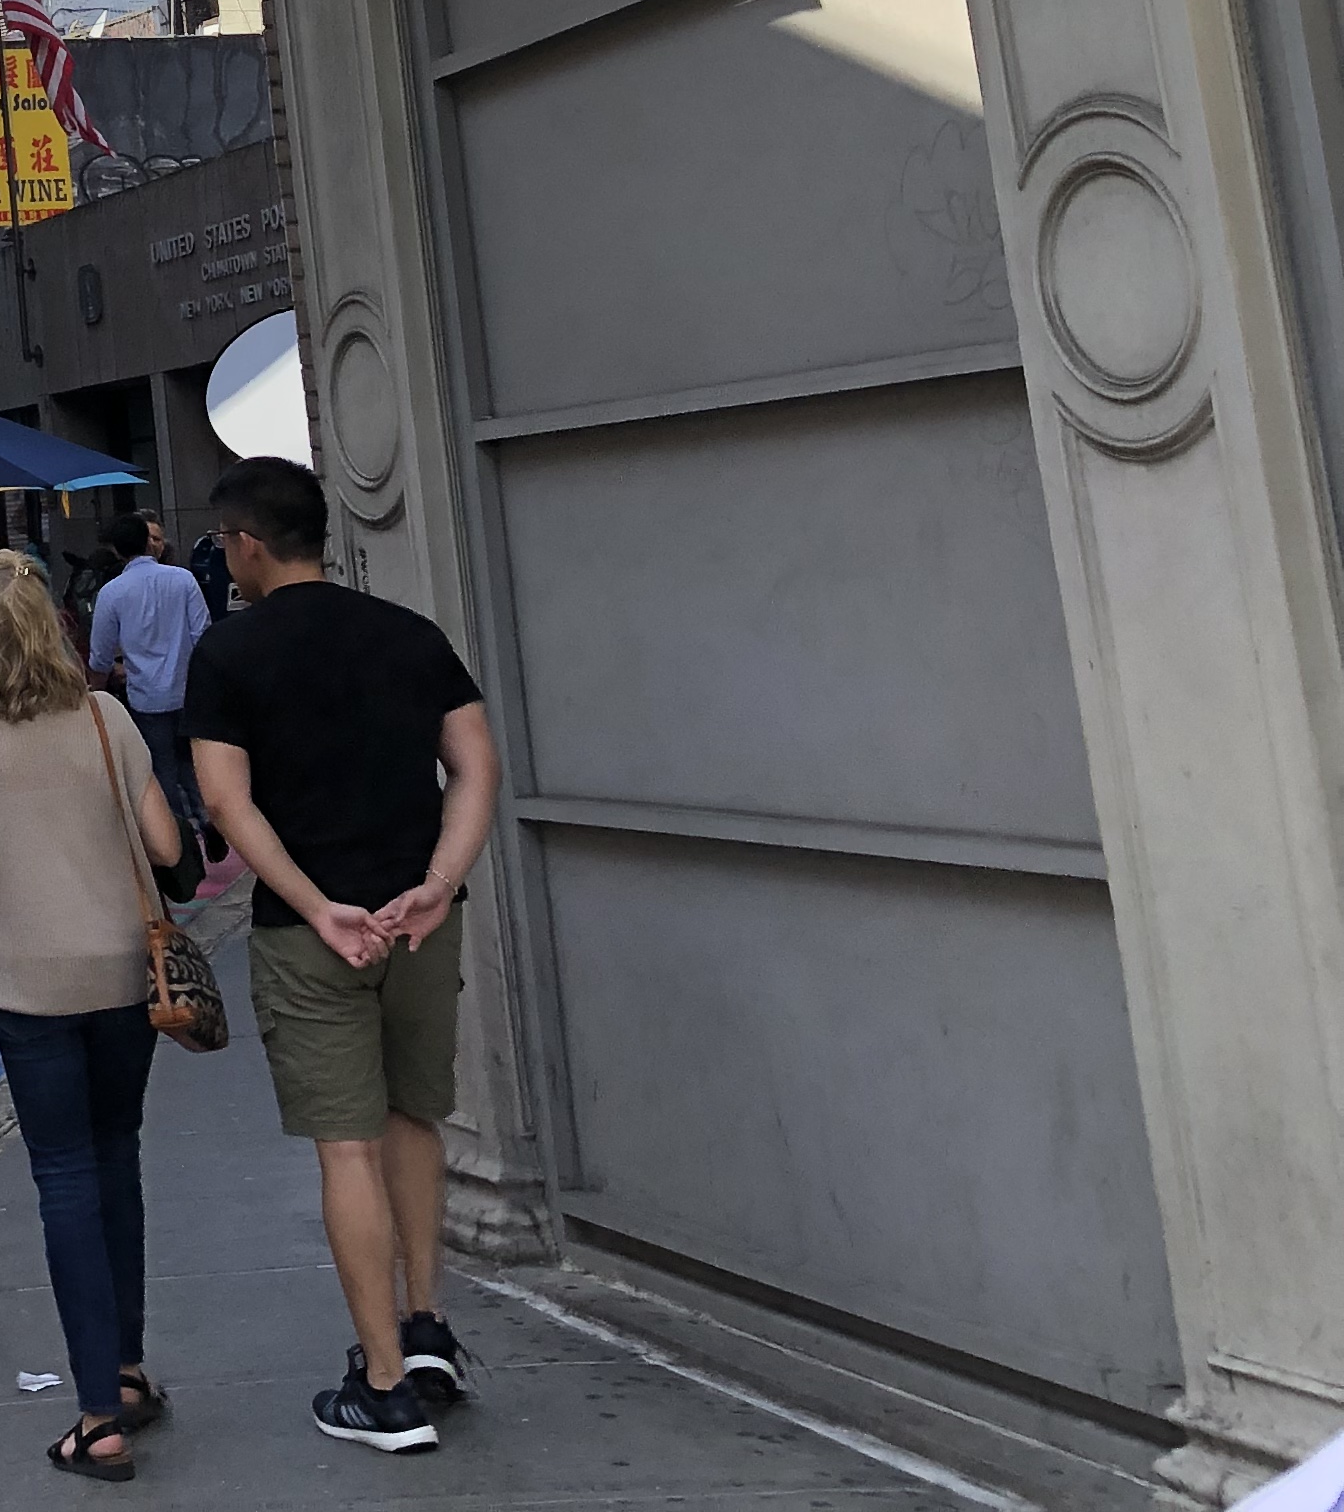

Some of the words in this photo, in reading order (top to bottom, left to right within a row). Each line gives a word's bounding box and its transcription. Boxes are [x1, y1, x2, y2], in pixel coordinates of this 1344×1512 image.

[150, 232, 194, 262] UNITED
[204, 214, 251, 248] STATES
[240, 284, 262, 304] NEW
